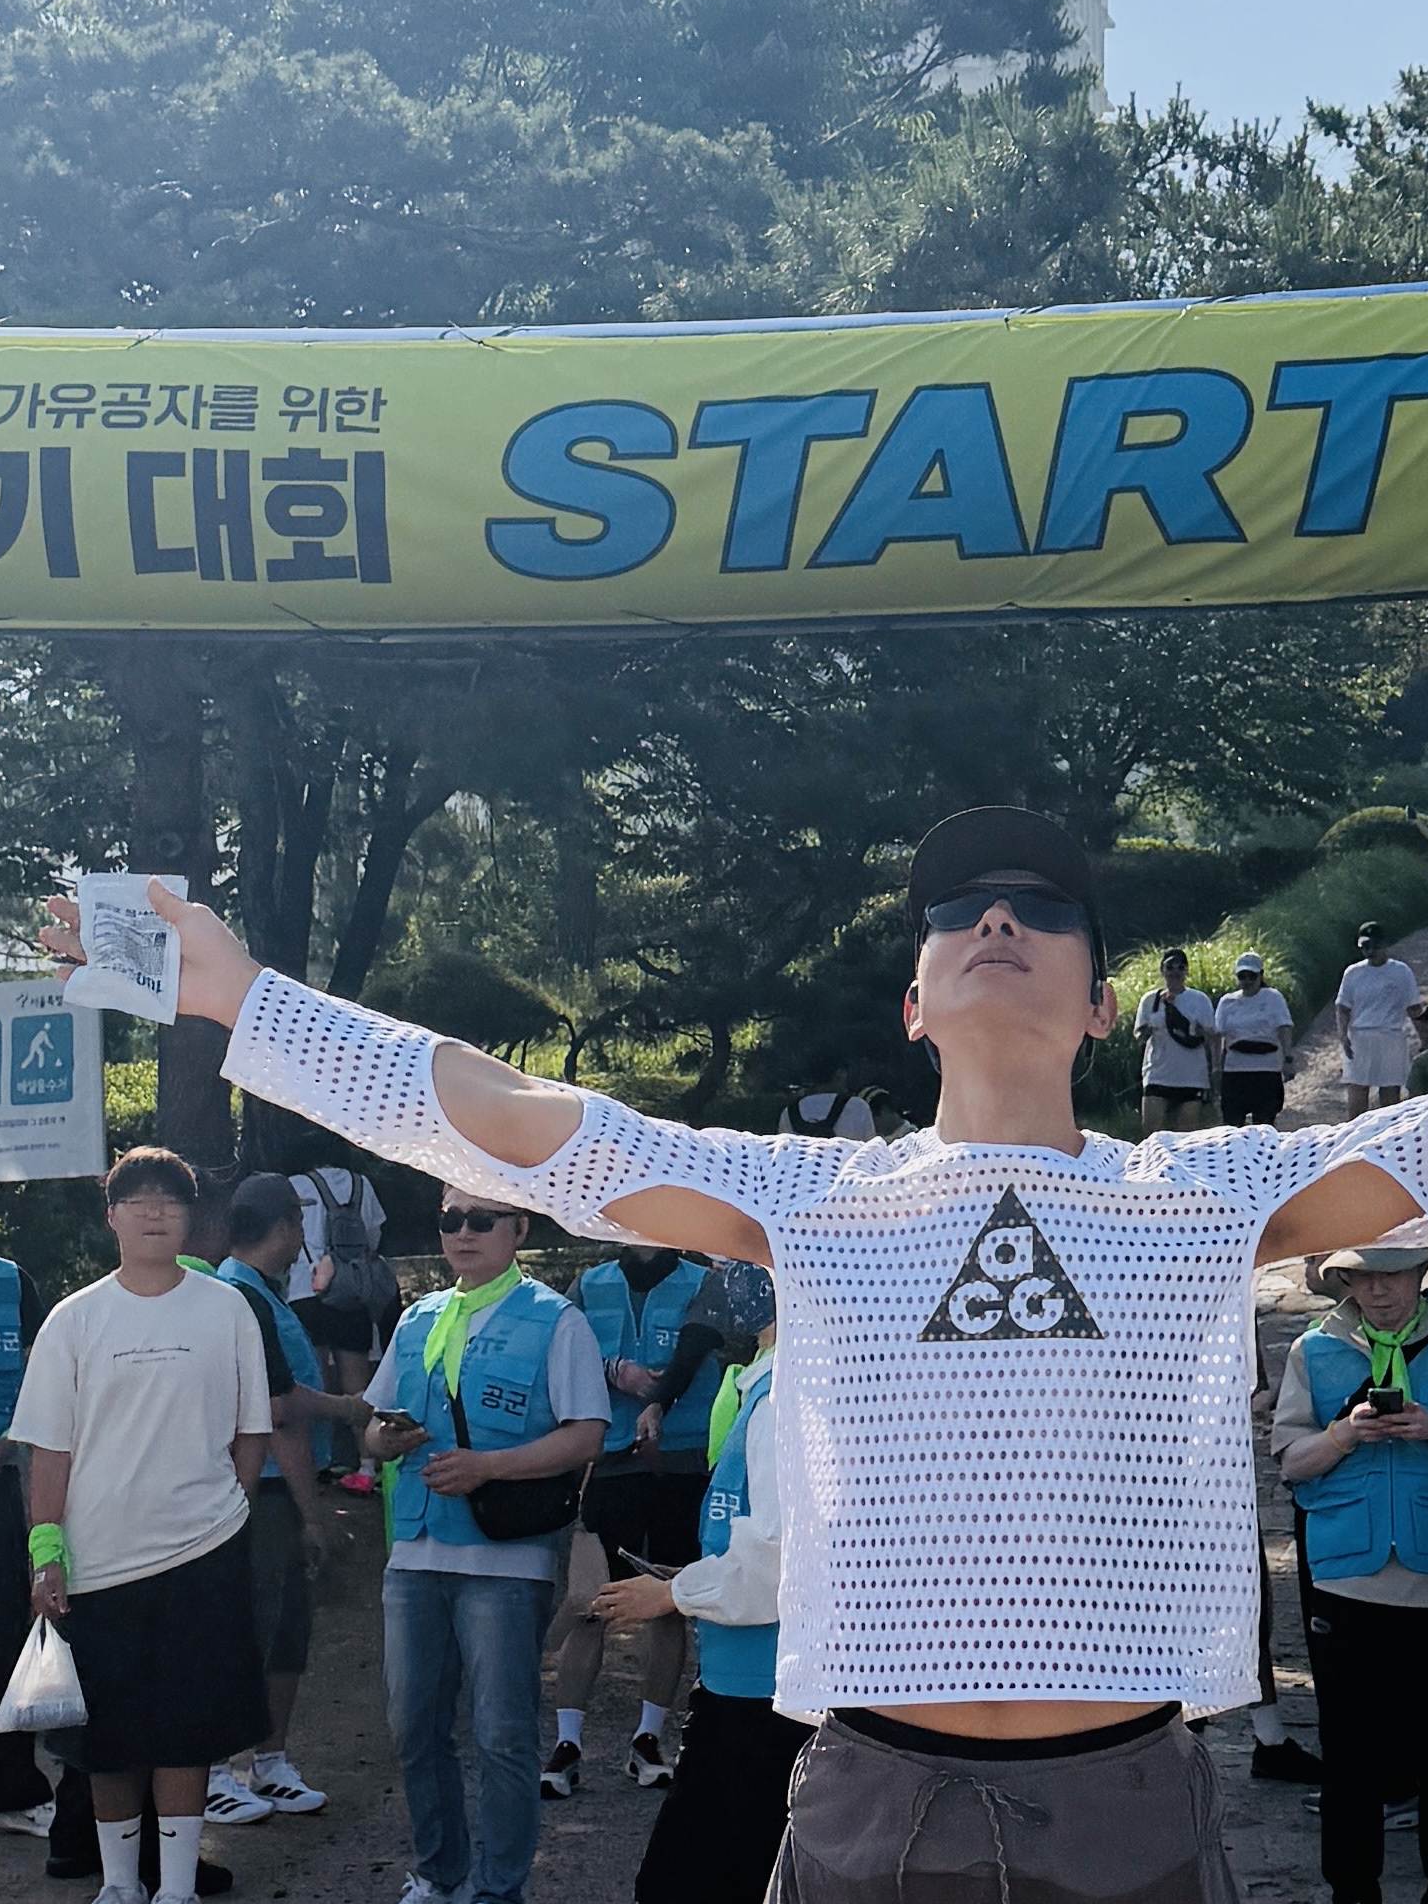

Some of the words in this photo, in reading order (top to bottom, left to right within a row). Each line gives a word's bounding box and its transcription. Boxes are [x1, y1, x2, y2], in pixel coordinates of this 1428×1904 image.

[278, 385, 388, 434] 위한
[127, 448, 392, 584] 대회
[480, 1382, 528, 1417] 공군
